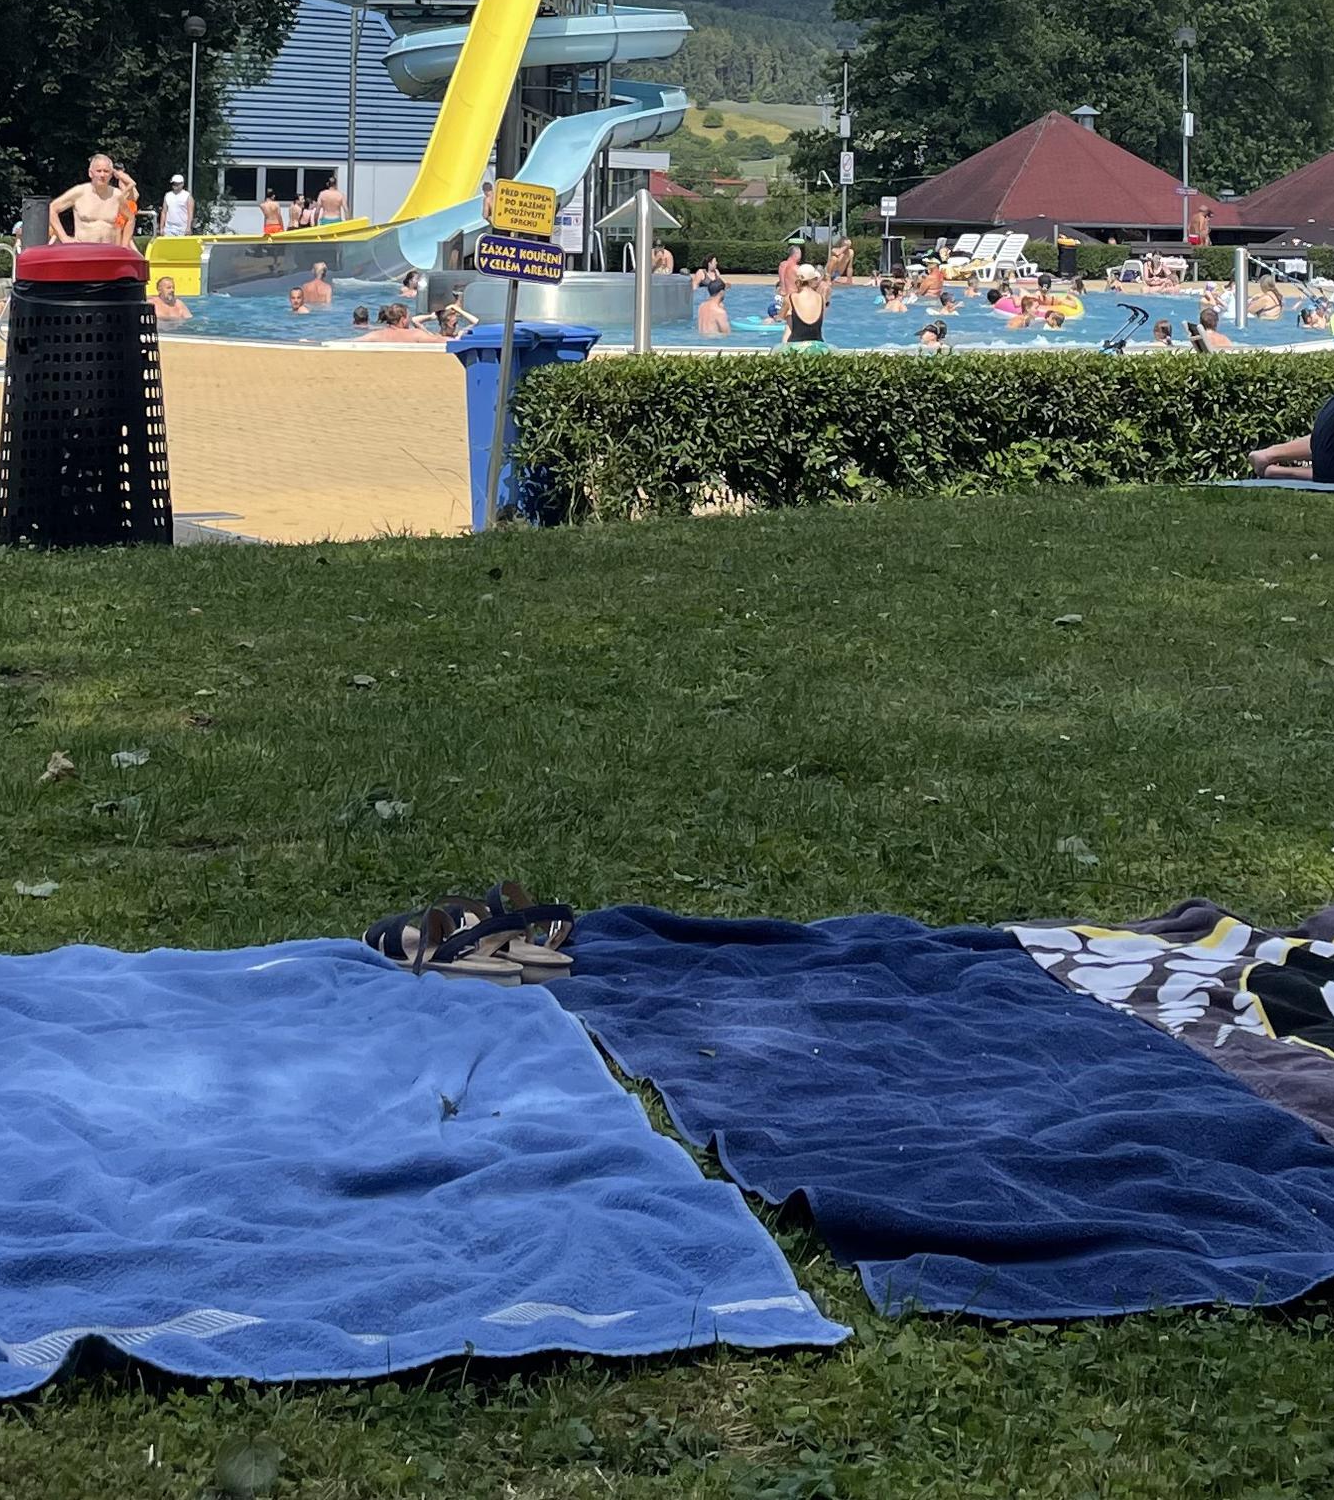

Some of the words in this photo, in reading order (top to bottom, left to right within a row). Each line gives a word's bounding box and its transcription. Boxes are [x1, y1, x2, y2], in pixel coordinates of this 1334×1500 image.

[480, 242, 517, 259] ZÁKAZ
[479, 257, 489, 269] V
[489, 258, 521, 274] CELÉM
[523, 263, 562, 279] AREÁLU
